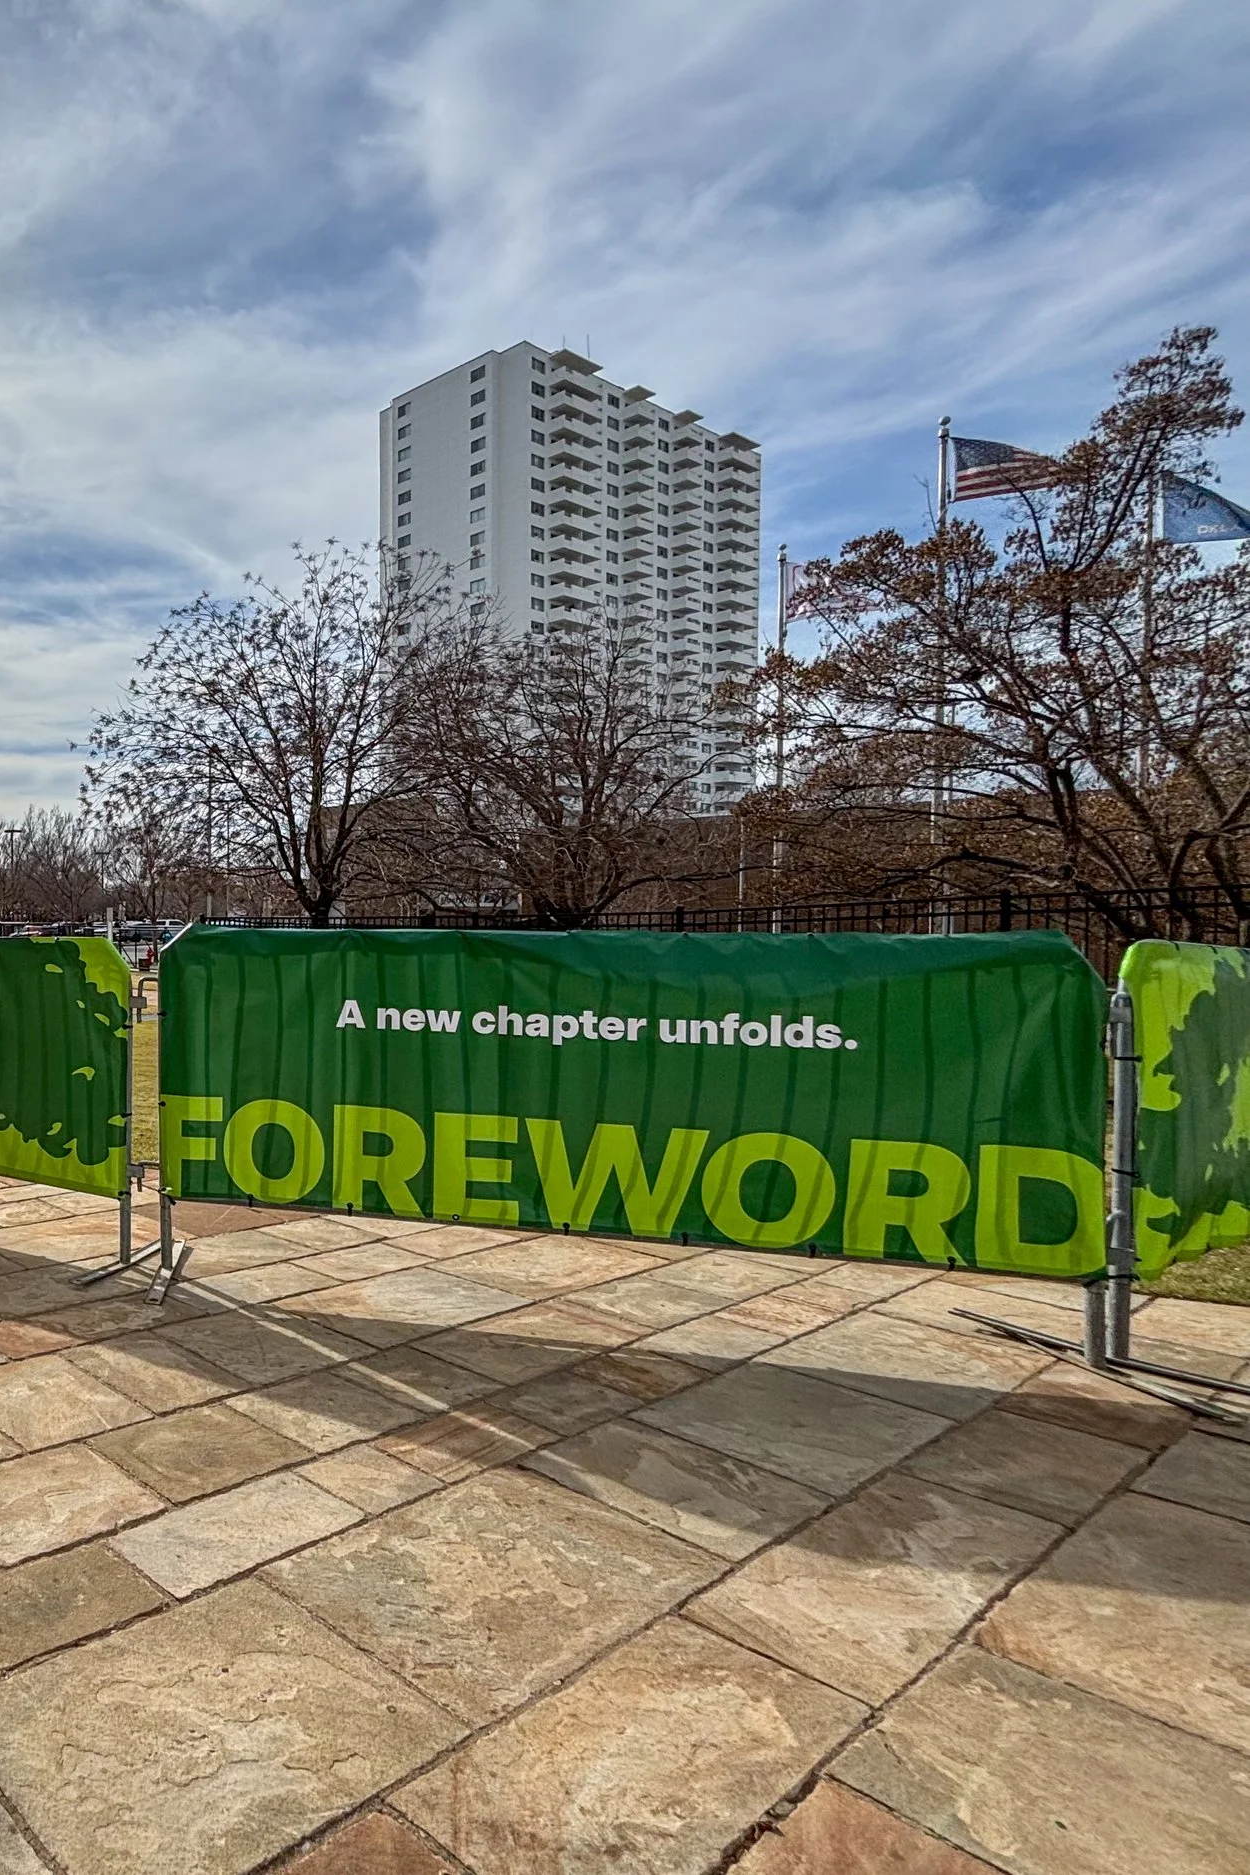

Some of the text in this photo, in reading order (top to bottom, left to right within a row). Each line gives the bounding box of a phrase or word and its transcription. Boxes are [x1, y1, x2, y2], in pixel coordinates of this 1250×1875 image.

[336, 1000, 858, 1051] A new chapter unfolds.
[160, 1094, 1106, 1277] FOREWORD
